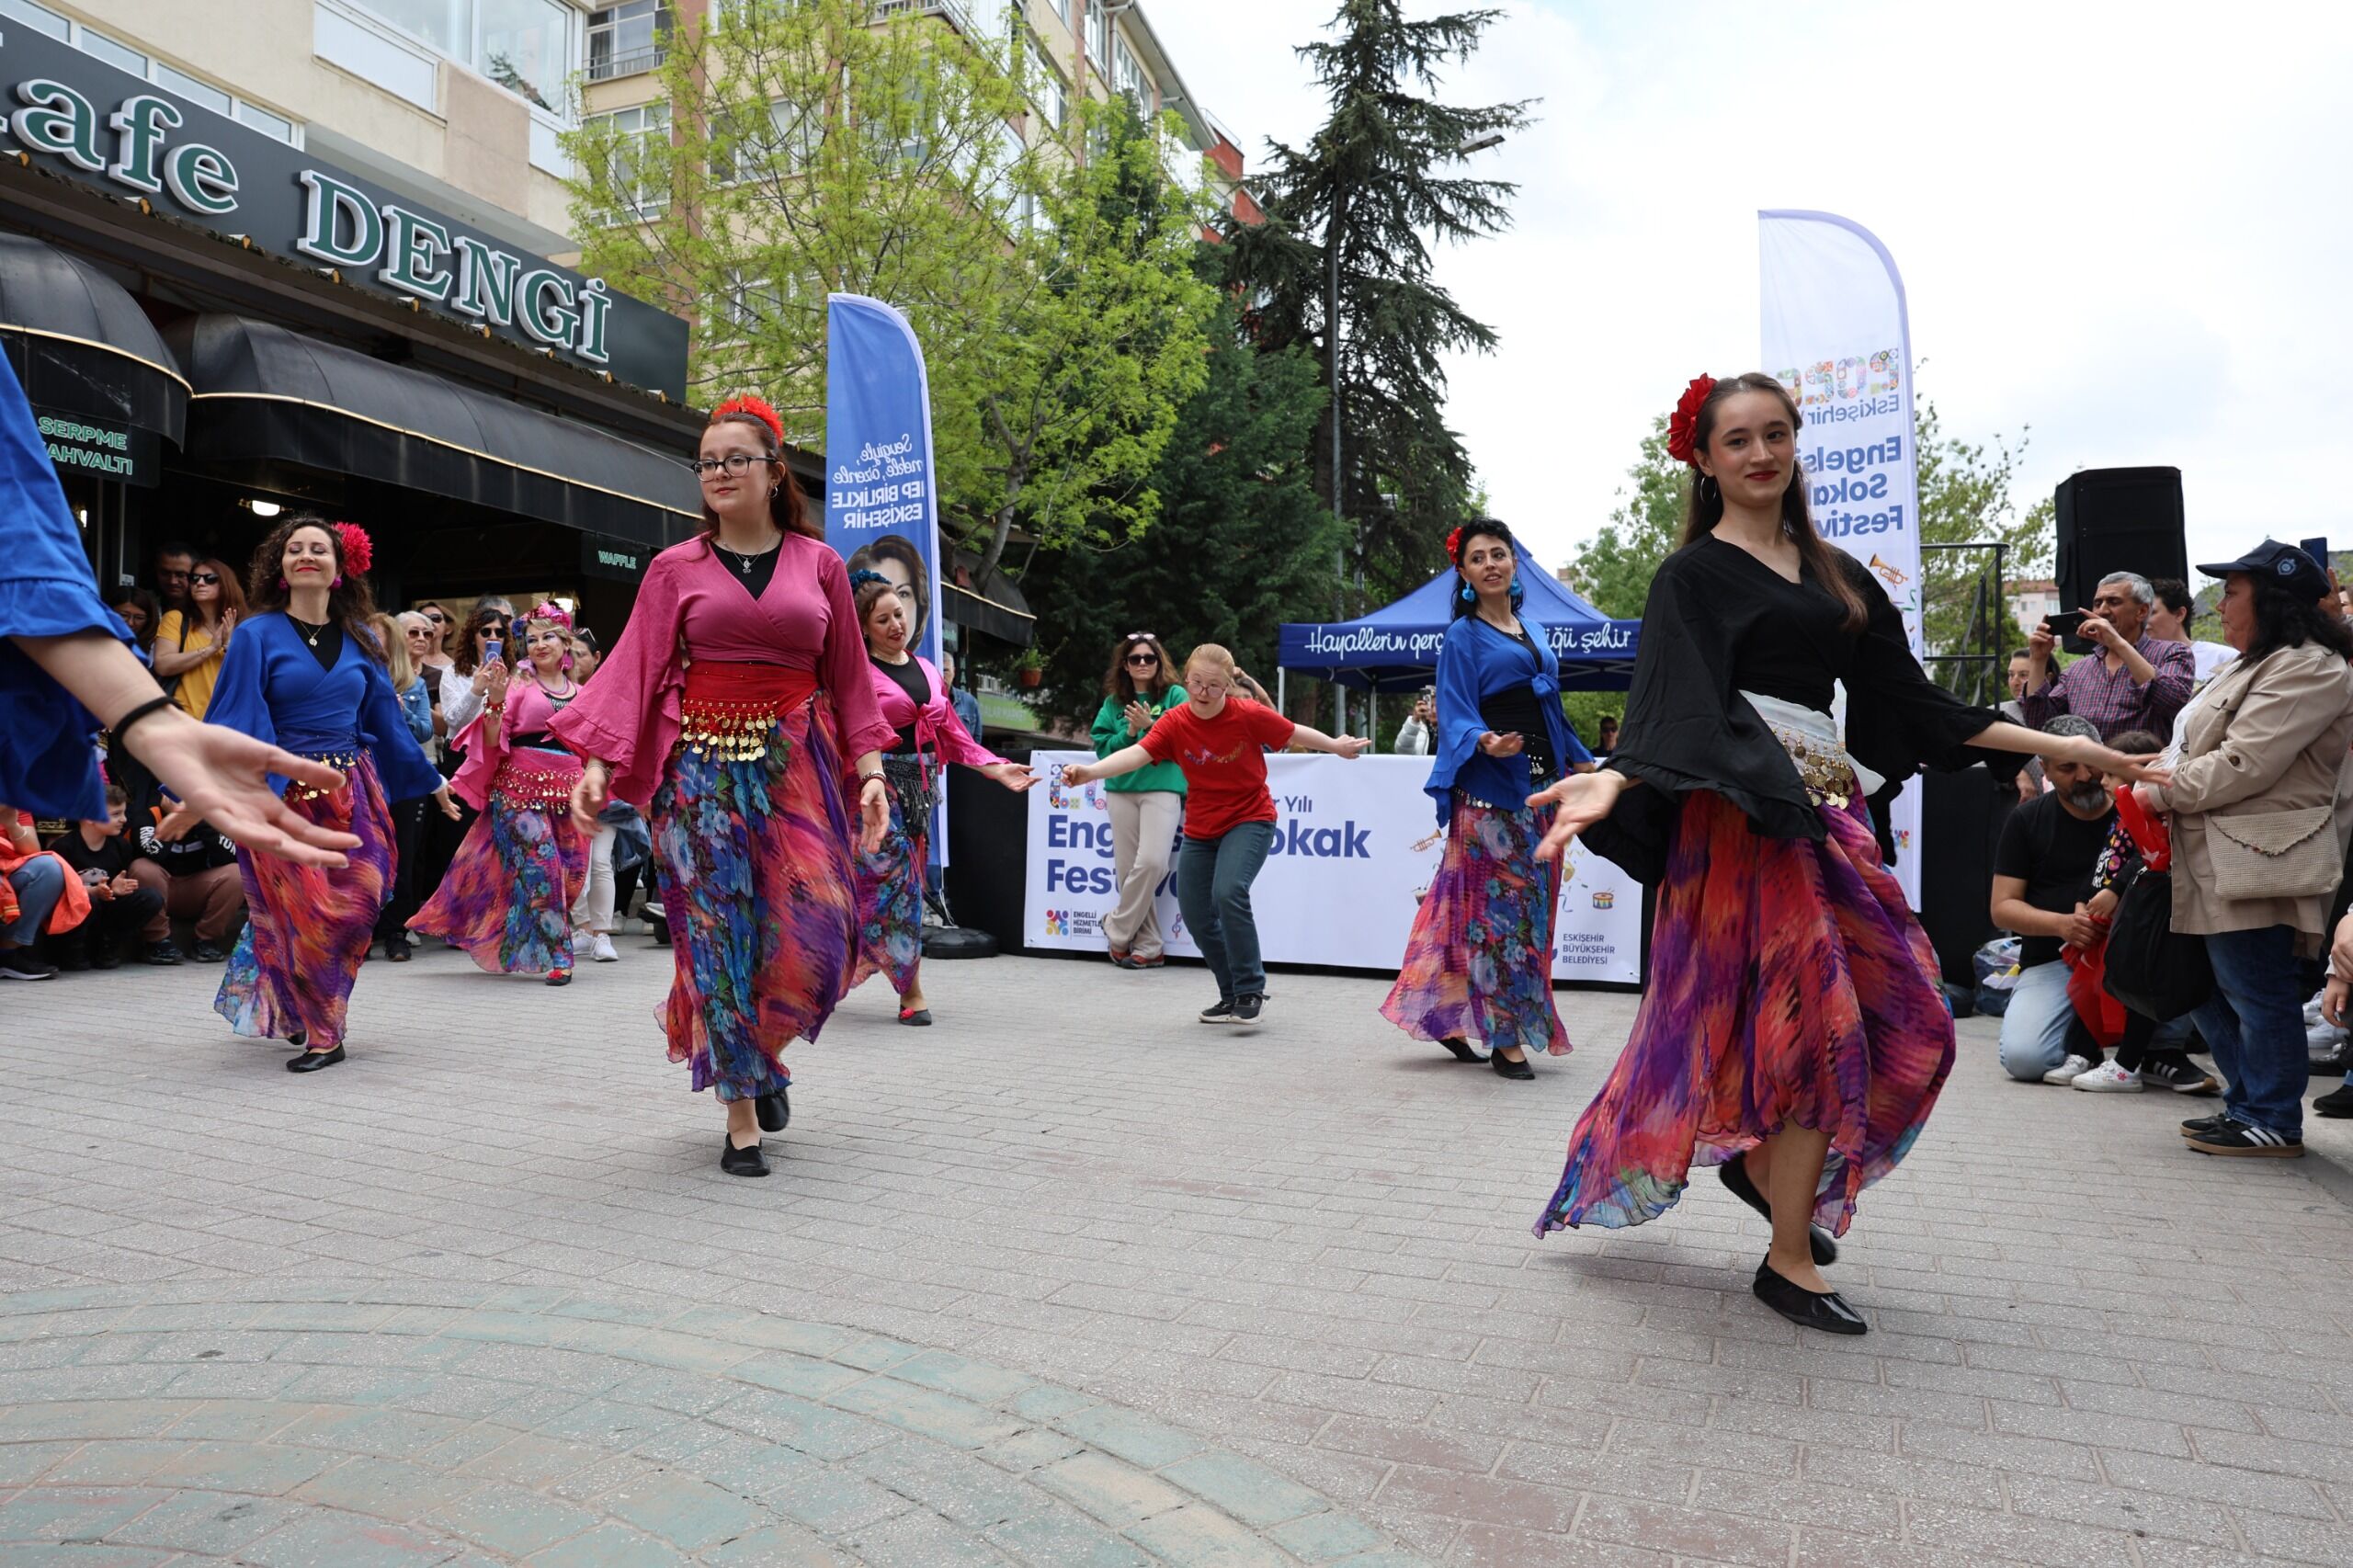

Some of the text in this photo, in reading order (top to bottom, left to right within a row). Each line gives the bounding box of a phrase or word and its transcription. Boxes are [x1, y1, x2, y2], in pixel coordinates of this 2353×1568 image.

[0, 33, 612, 363] afe DENGİ
[38, 416, 128, 450] SERPME
[42, 441, 133, 475] AHVALTI
[597, 551, 637, 570] WAFFLE
[1304, 626, 1407, 661] Hayallerin
[1410, 632, 1444, 660] gerç
[1581, 622, 1631, 653] şehir
[1284, 795, 1313, 812] Yılı
[1267, 819, 1372, 858] okak
[1563, 932, 1605, 943] ESKİŞEHİR
[1563, 943, 1616, 954] BÜYÜKŞEHİR
[1563, 955, 1608, 965] BELEDİYESİ
